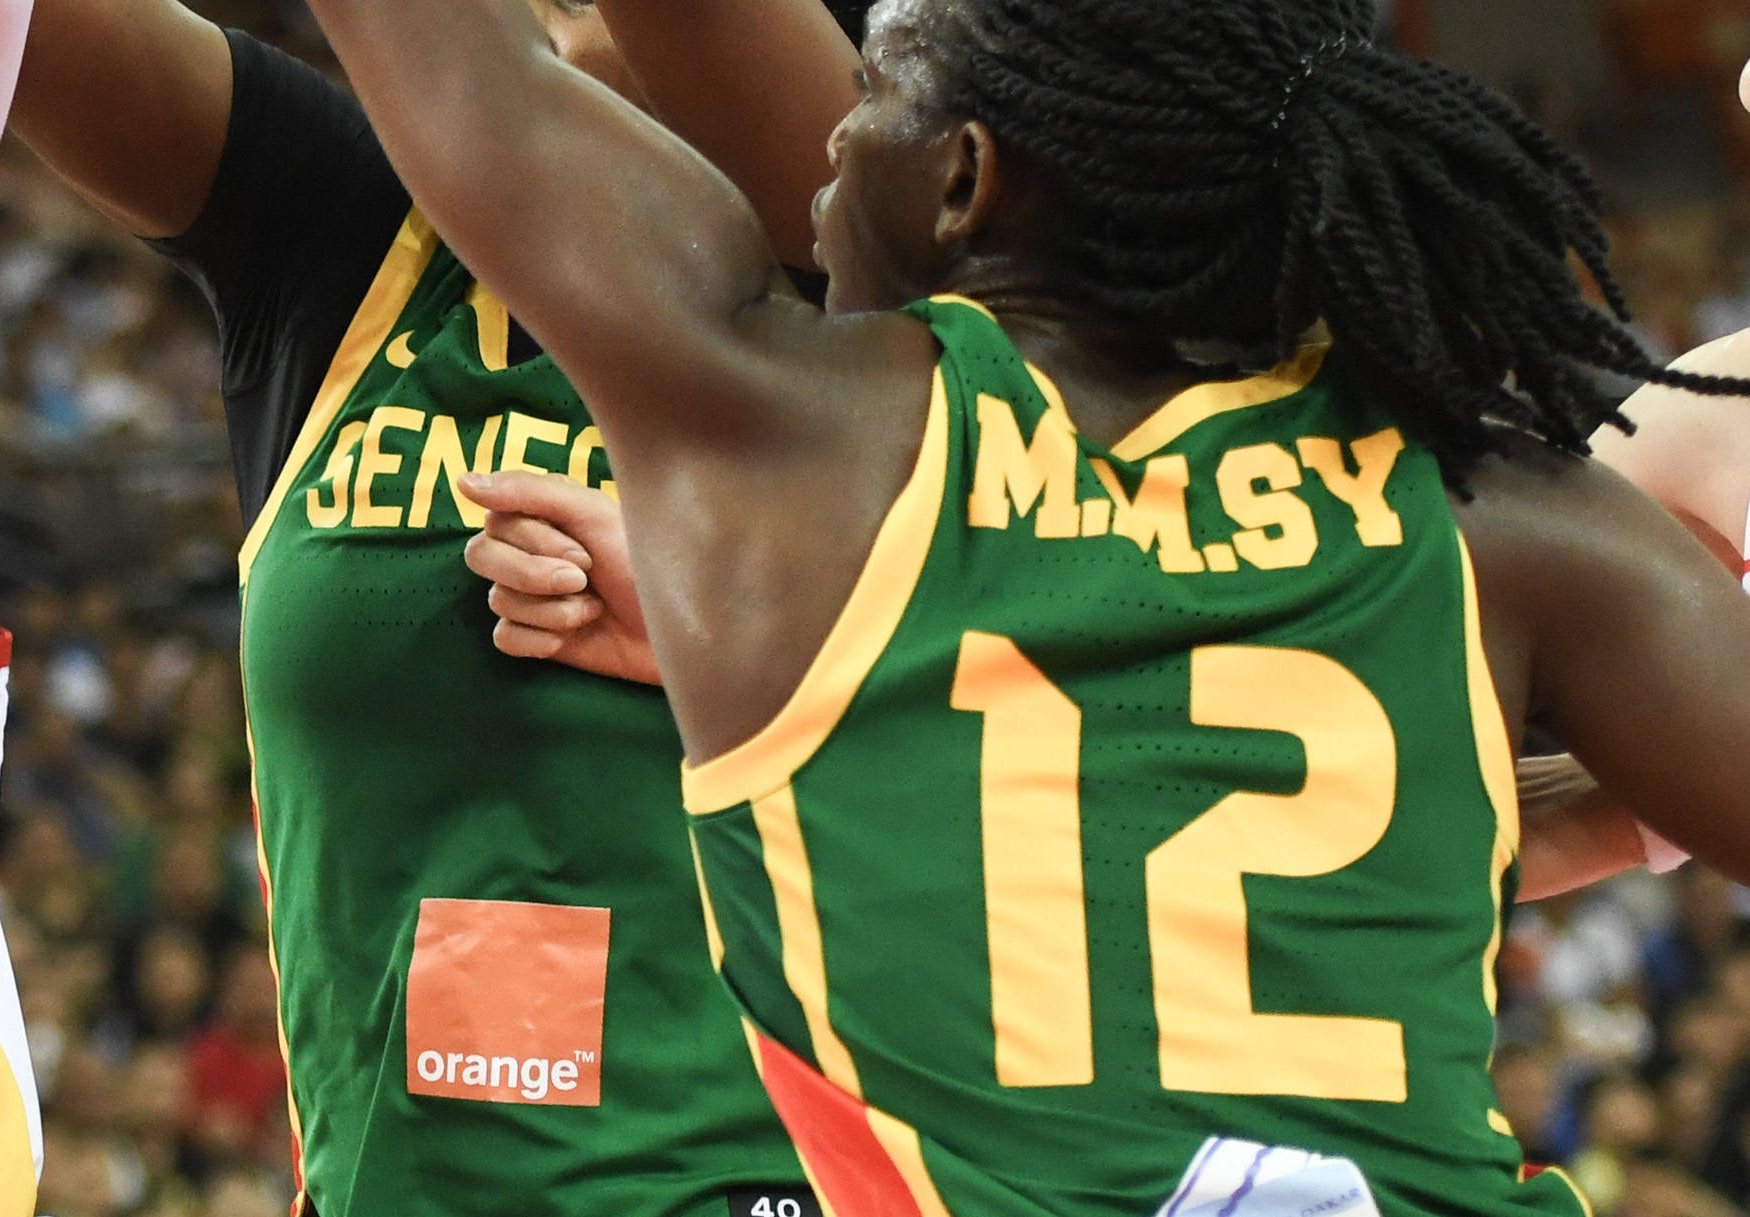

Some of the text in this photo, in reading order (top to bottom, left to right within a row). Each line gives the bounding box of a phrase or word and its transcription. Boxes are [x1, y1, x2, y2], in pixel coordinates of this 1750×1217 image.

[950, 629, 1408, 1102] 12
[417, 1050, 579, 1100] orange
[750, 1196, 801, 1217] 40
